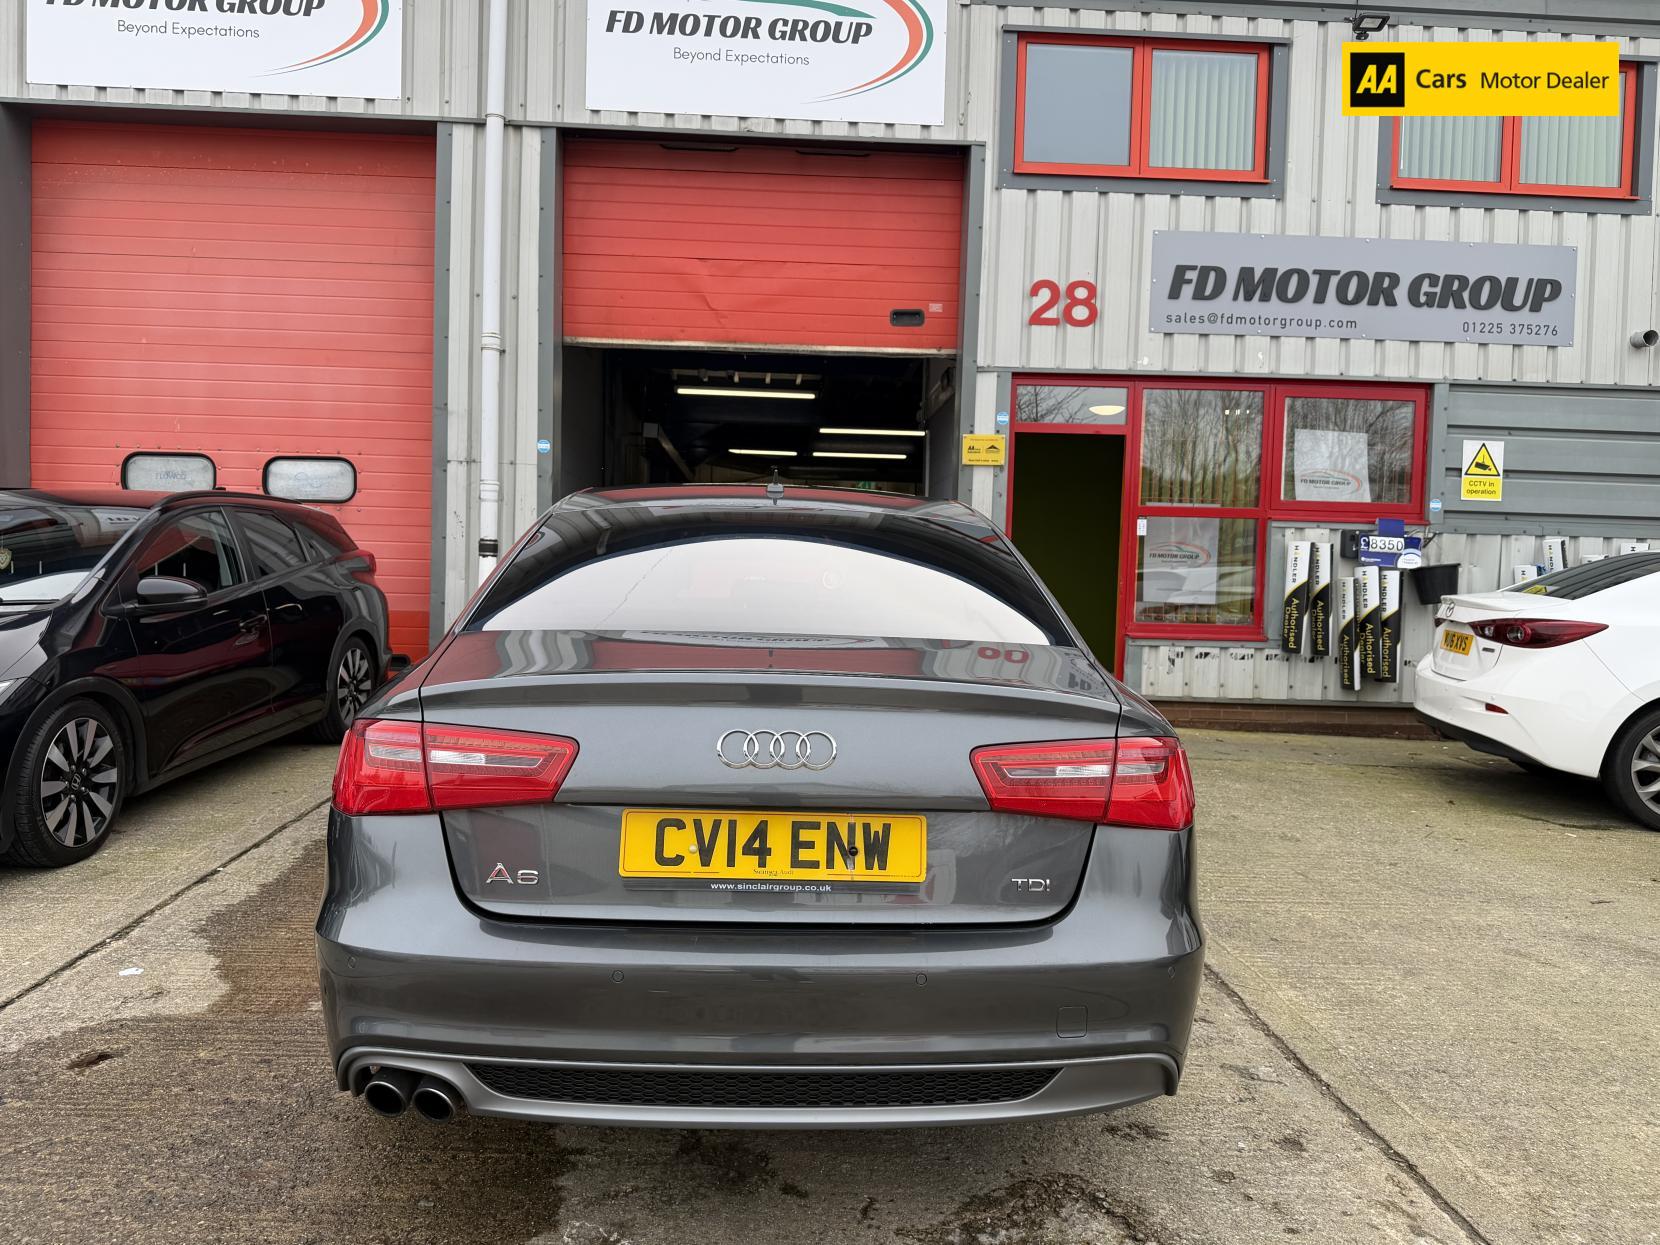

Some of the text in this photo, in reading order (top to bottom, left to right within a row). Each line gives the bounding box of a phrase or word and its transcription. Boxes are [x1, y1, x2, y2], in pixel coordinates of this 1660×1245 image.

[117, 19, 260, 39] Beyond Expectations
[605, 10, 872, 45] FD MOTOR GROUP
[673, 46, 810, 66] Beyond Expectations
[1028, 279, 1098, 327] 28
[1168, 264, 1562, 313] FD MOTOR GROUP
[1165, 312, 1357, 330] sales@fdmotorgroup.com
[1462, 321, 1558, 337] 01225 375276
[1291, 545, 1300, 583] HANDLER
[1288, 598, 1300, 649] Authorised
[1316, 600, 1325, 651] Authorised
[1365, 622, 1376, 674] Authorised
[1382, 627, 1392, 678] Authorised
[654, 817, 891, 871] CV14 ENW
[486, 862, 539, 885] A6
[710, 882, 832, 892] www.sinclairgroup.co.uk
